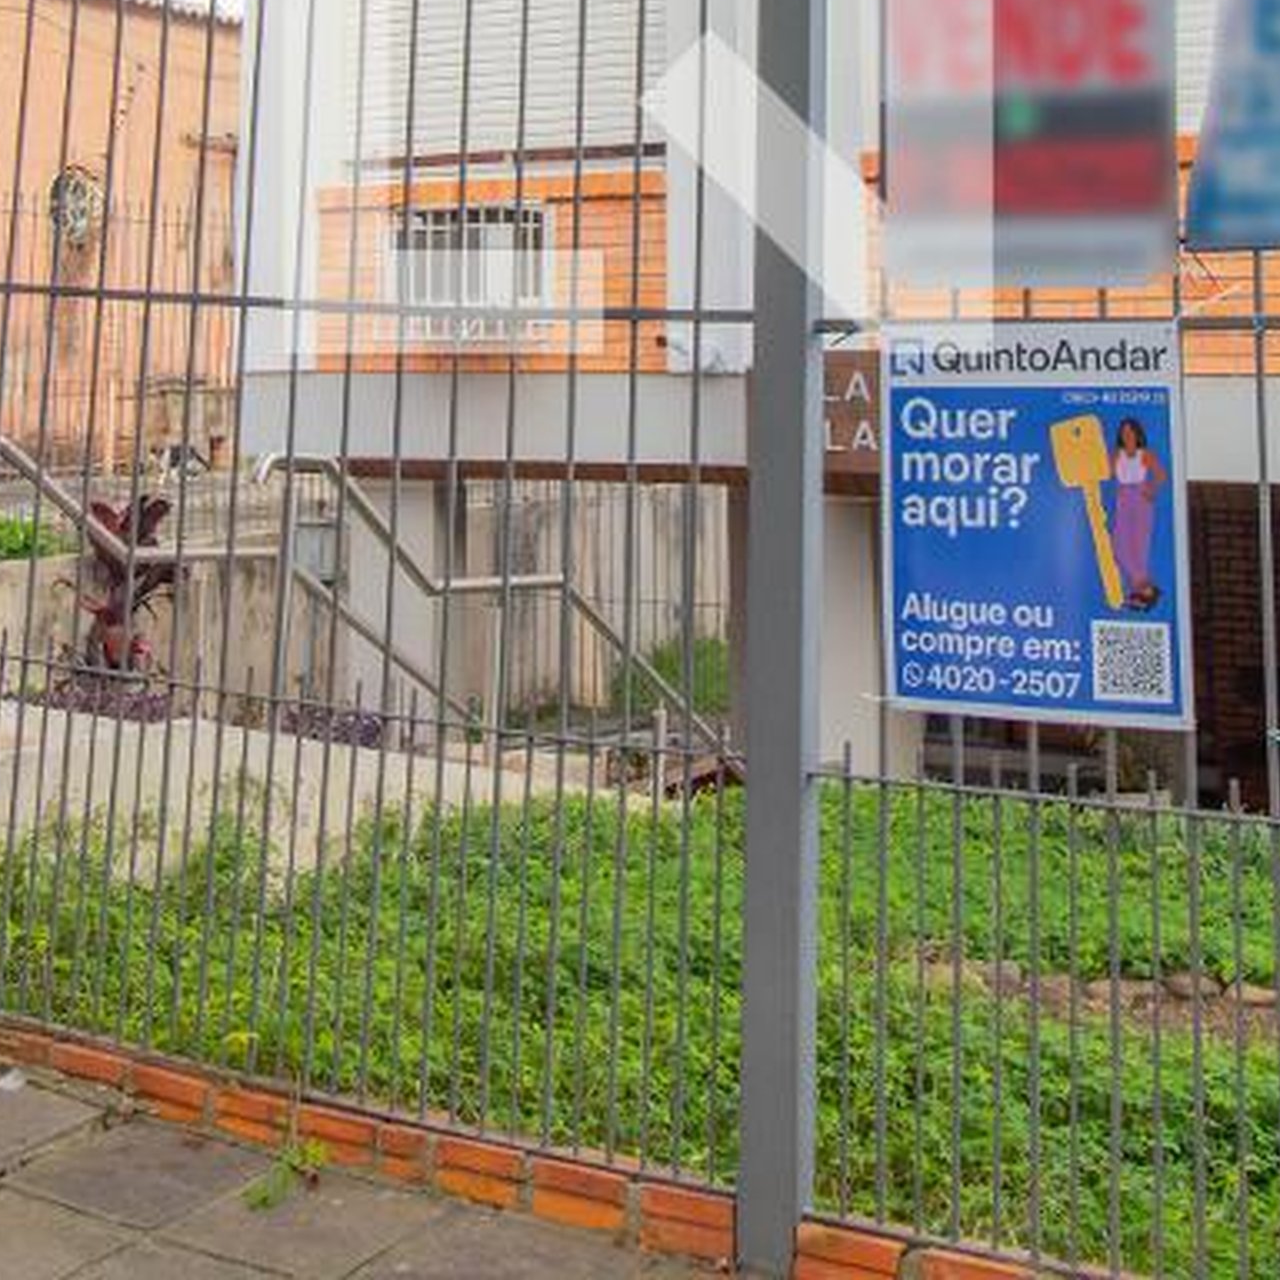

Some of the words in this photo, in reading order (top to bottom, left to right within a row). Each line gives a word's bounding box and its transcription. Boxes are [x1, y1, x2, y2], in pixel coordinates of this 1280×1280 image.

[933, 339, 1168, 375] QuintoAndar
[900, 396, 1017, 441] Quer
[901, 450, 1041, 485] morar
[902, 486, 1029, 538] aqui?
[901, 591, 1007, 631] Alugue
[1012, 604, 1054, 628] ou
[901, 630, 1015, 662] compre
[1022, 636, 1082, 662] em:
